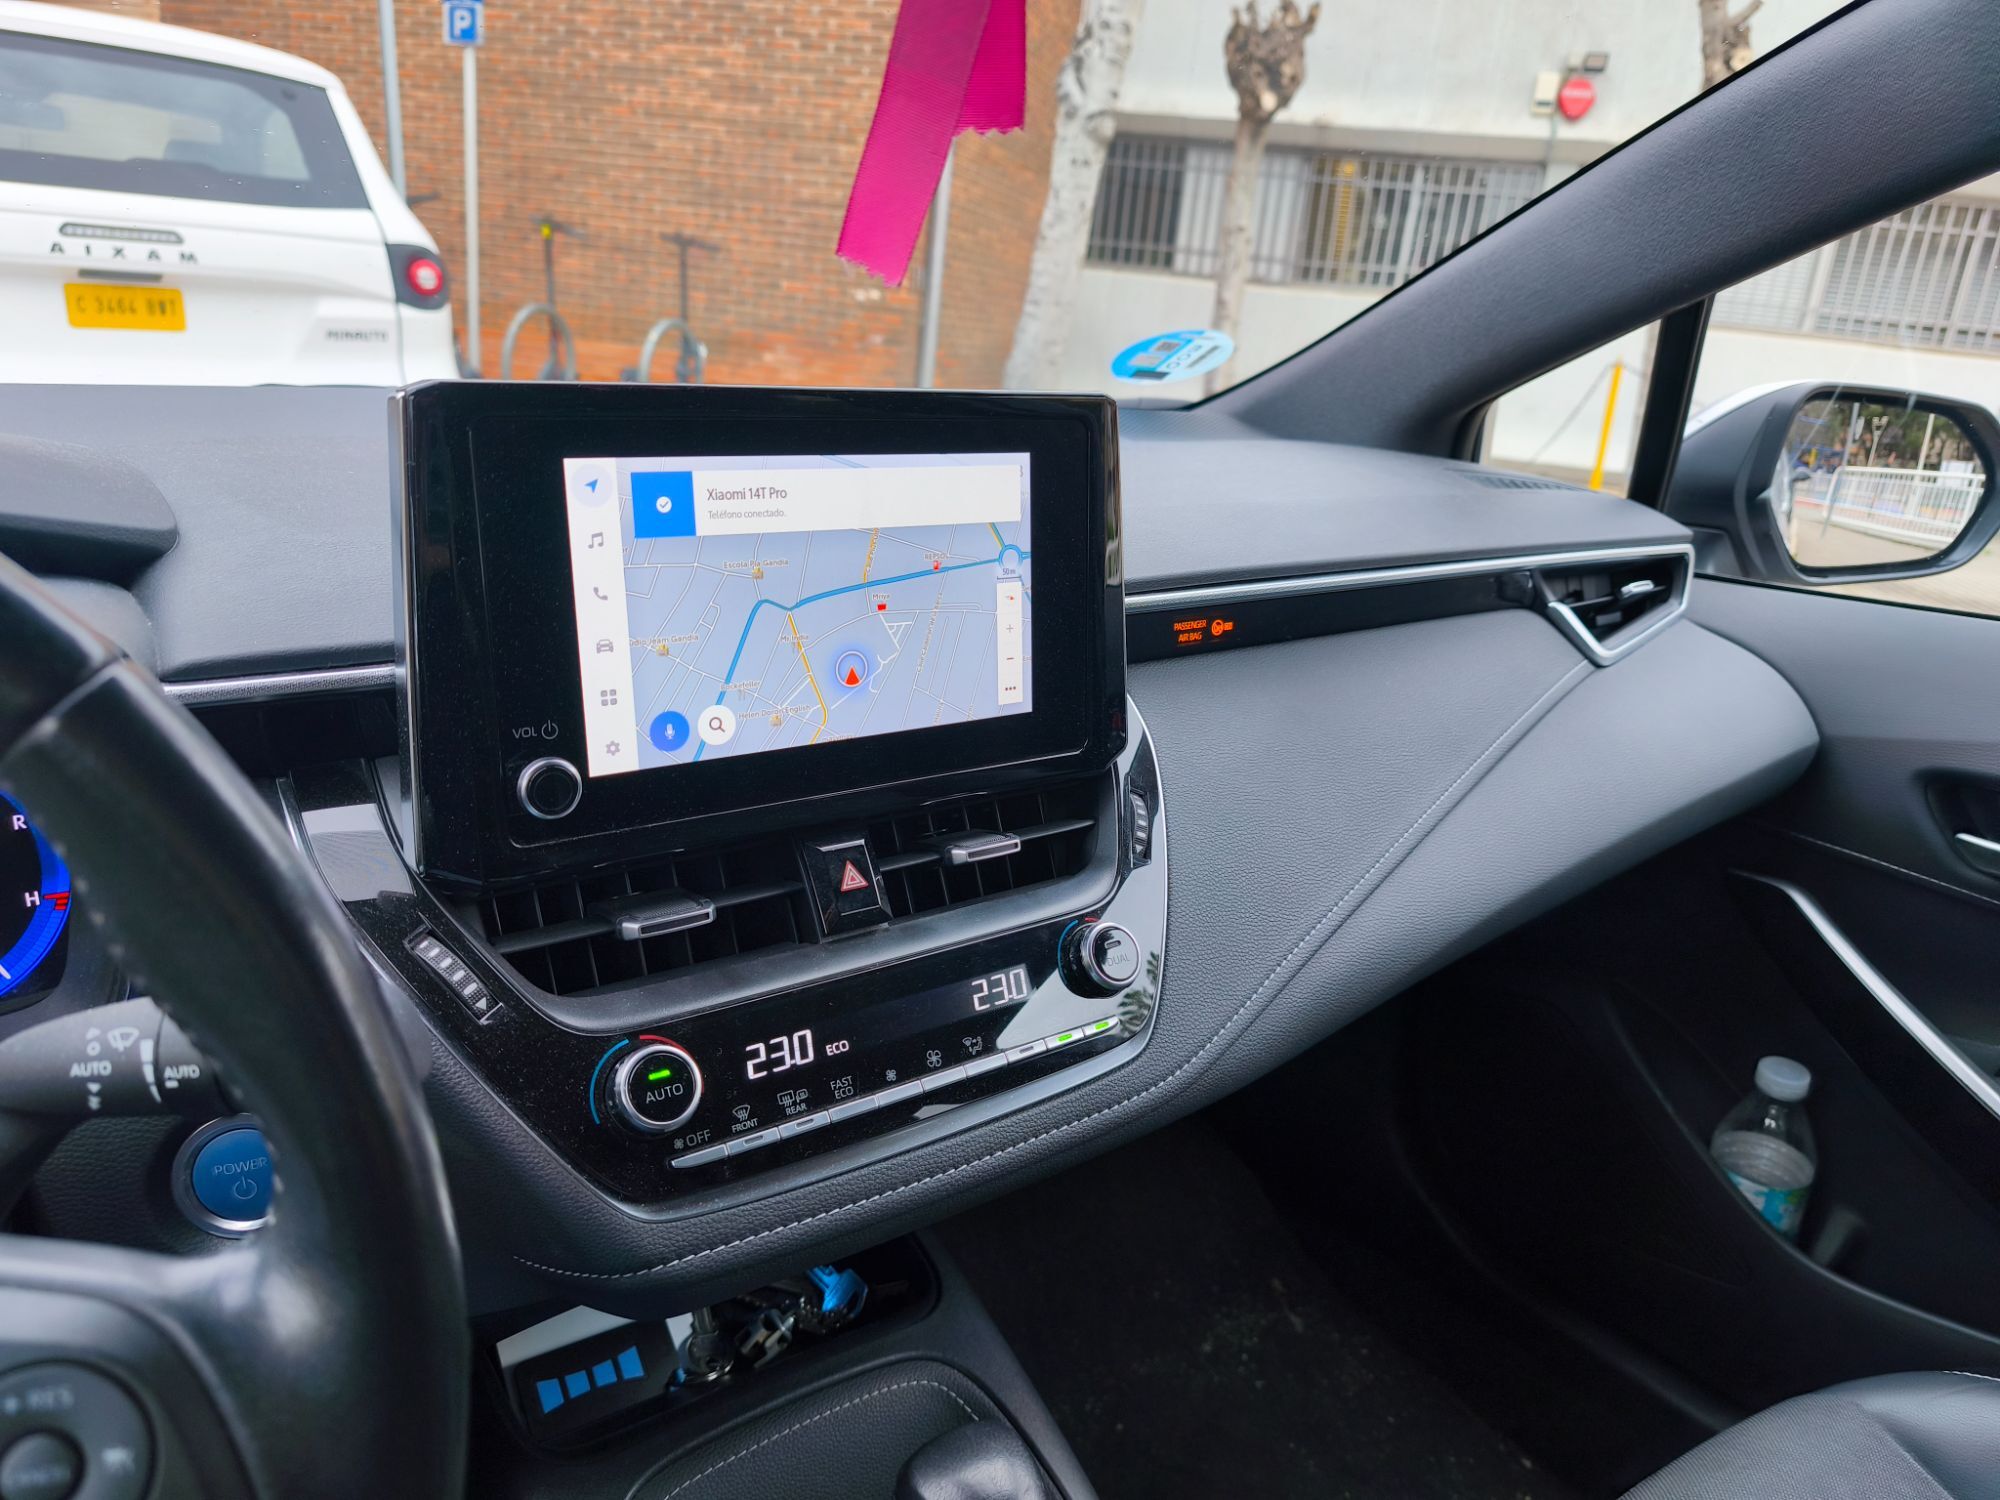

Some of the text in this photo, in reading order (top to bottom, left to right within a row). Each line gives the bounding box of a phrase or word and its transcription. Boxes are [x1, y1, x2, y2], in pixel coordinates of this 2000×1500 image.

[453, 8, 472, 38] P
[50, 242, 198, 263] AIXAM
[706, 486, 788, 501] Xiaomi 14T Pro
[708, 509, 743, 520] Teléfono
[723, 560, 748, 569] Escola
[762, 558, 789, 567] Gandia
[1173, 619, 1207, 631] PASSENGER
[671, 634, 699, 643] Gandia
[738, 711, 760, 719] Helen
[785, 704, 811, 714] English
[512, 726, 538, 739] VOL
[12, 814, 28, 830] R
[24, 890, 41, 907] H
[1106, 952, 1131, 967] DUAL
[825, 1039, 850, 1057] ECO
[70, 1059, 112, 1078] AUTO
[163, 1063, 201, 1080] AUTO
[830, 1075, 853, 1091] FAST
[646, 1083, 684, 1104] AUTO
[834, 1086, 854, 1100] ECO
[785, 1102, 808, 1116] REAR
[731, 1117, 759, 1134] FRONT
[686, 1128, 712, 1147] OFF
[213, 1156, 269, 1176] POWER
